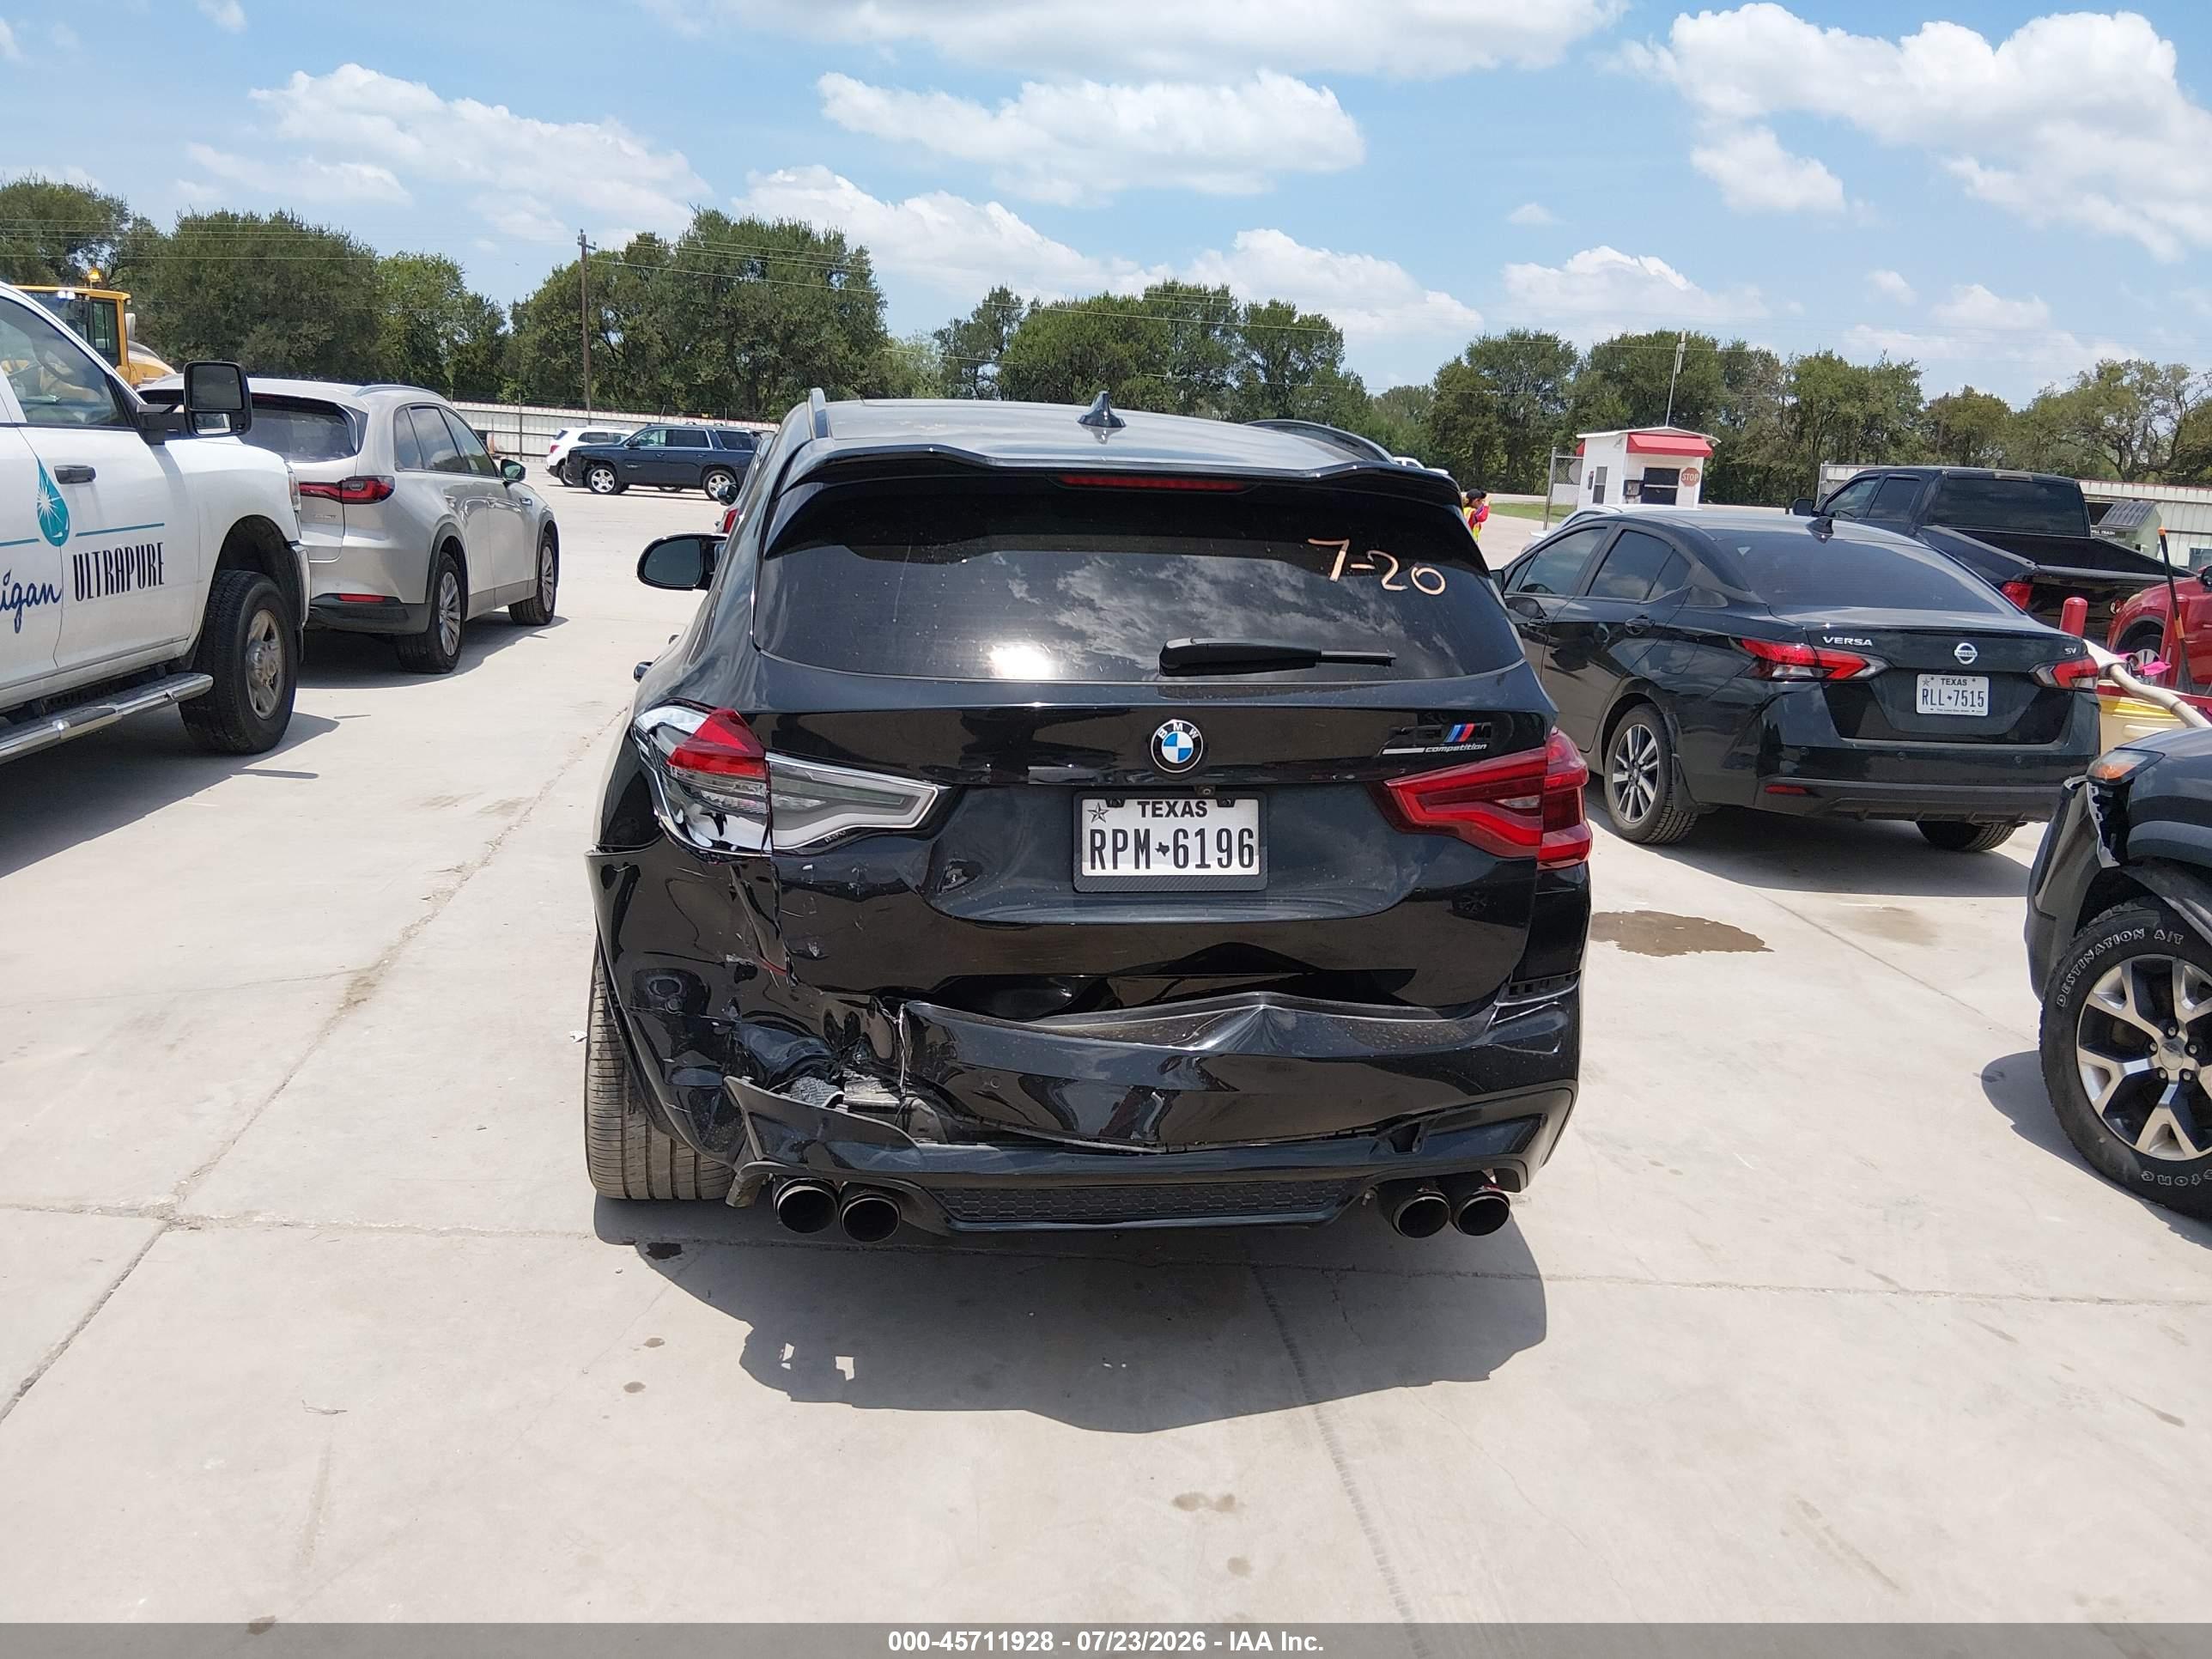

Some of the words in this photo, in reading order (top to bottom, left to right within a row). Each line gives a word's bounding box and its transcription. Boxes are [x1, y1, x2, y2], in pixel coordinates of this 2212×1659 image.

[1681, 473, 1699, 482] STOP
[1306, 538, 1447, 596] 7-20
[0, 567, 63, 635] igan
[72, 542, 165, 602] ULTRAPURE
[1822, 636, 1873, 647] VERSA
[1941, 678, 1968, 686] TEXAS
[1158, 722, 1200, 739] BMW
[1425, 742, 1487, 753] competition
[1137, 800, 1208, 818] TEXAS
[2056, 927, 2146, 1008] DESTINATION
[2154, 929, 2185, 945] A/T
[2141, 1169, 2212, 1187] stone
